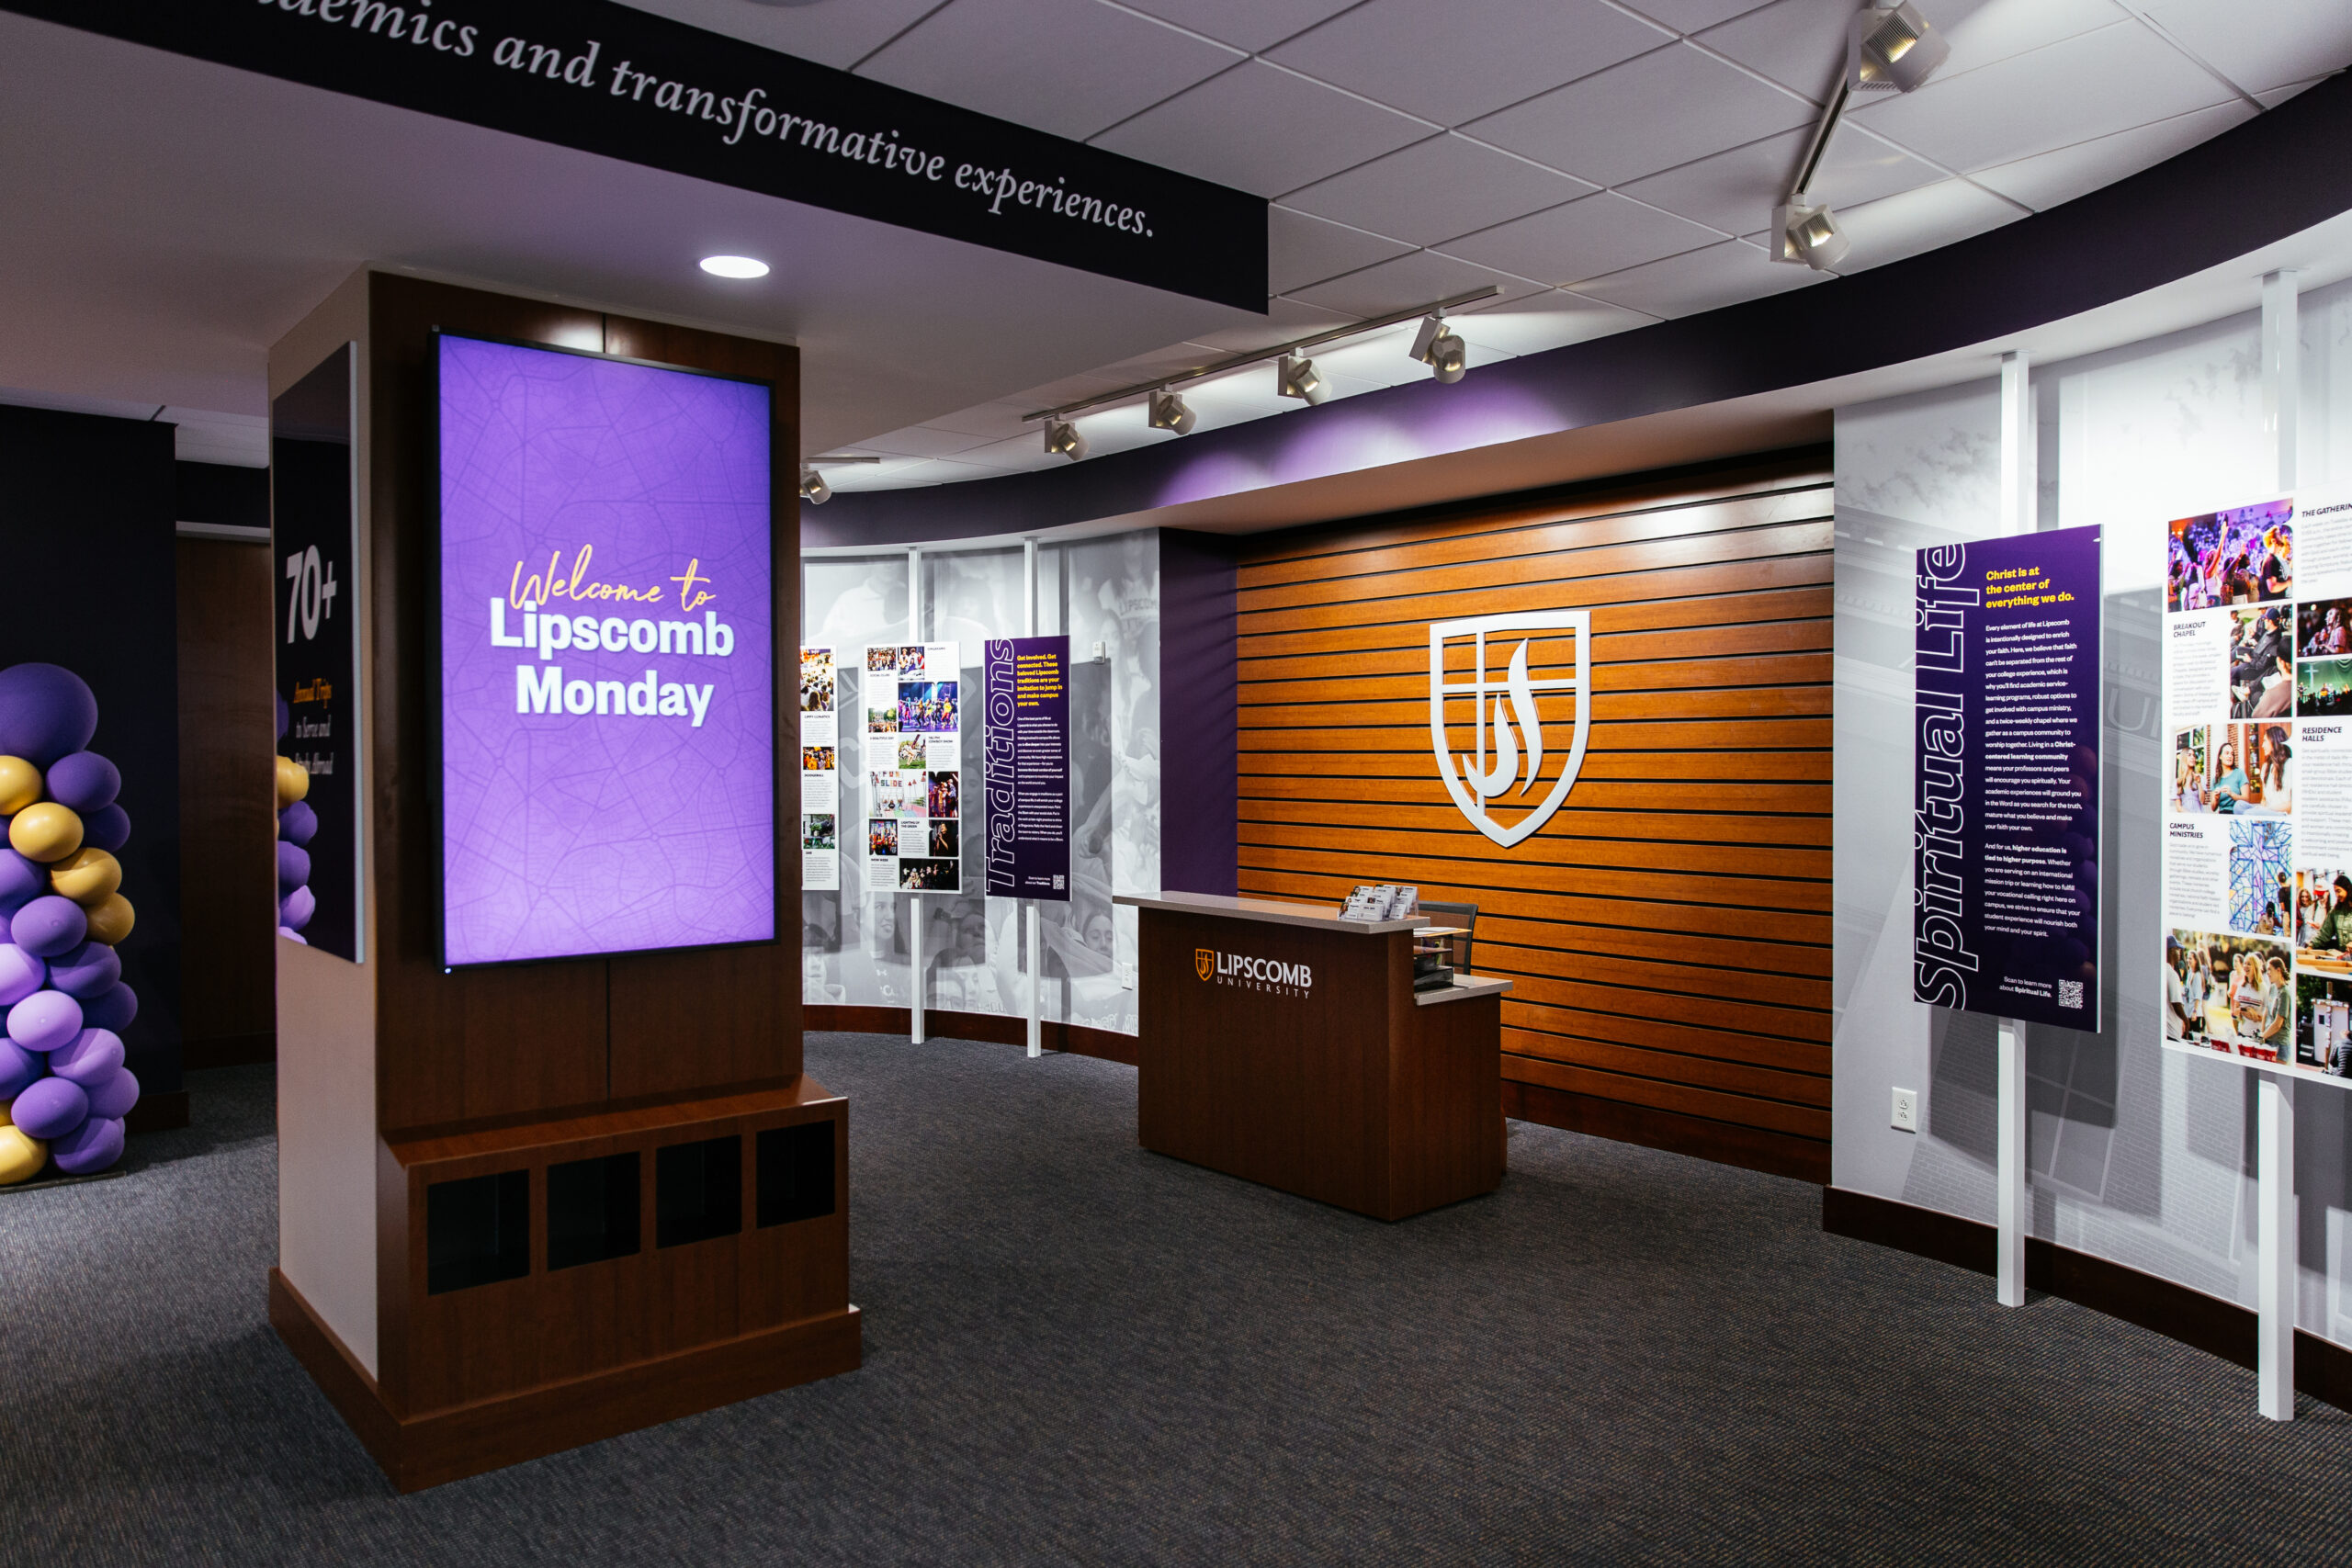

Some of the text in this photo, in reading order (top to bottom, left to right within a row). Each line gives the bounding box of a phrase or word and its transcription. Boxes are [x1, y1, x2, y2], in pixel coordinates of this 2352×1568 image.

[258, 0, 1154, 238] emics and transformative experiences.
[2301, 509, 2315, 517] THE
[510, 543, 717, 612] Welcome to
[1986, 567, 2040, 581] Christ is at
[1986, 579, 2050, 594] the center of
[286, 545, 337, 644] 70+
[1985, 595, 2040, 608] everything
[2058, 592, 2075, 602] do.
[491, 597, 735, 660] Lipscomb
[2173, 621, 2206, 630] BREAKOUT
[516, 664, 715, 728] Monday
[985, 637, 1015, 892] Traditions
[1915, 542, 1981, 1010] Spiritual Life
[2169, 830, 2203, 839] MINISTRIES
[1216, 952, 1312, 987] LIPSCOMB
[1216, 976, 1310, 999] UNIVERSITY
